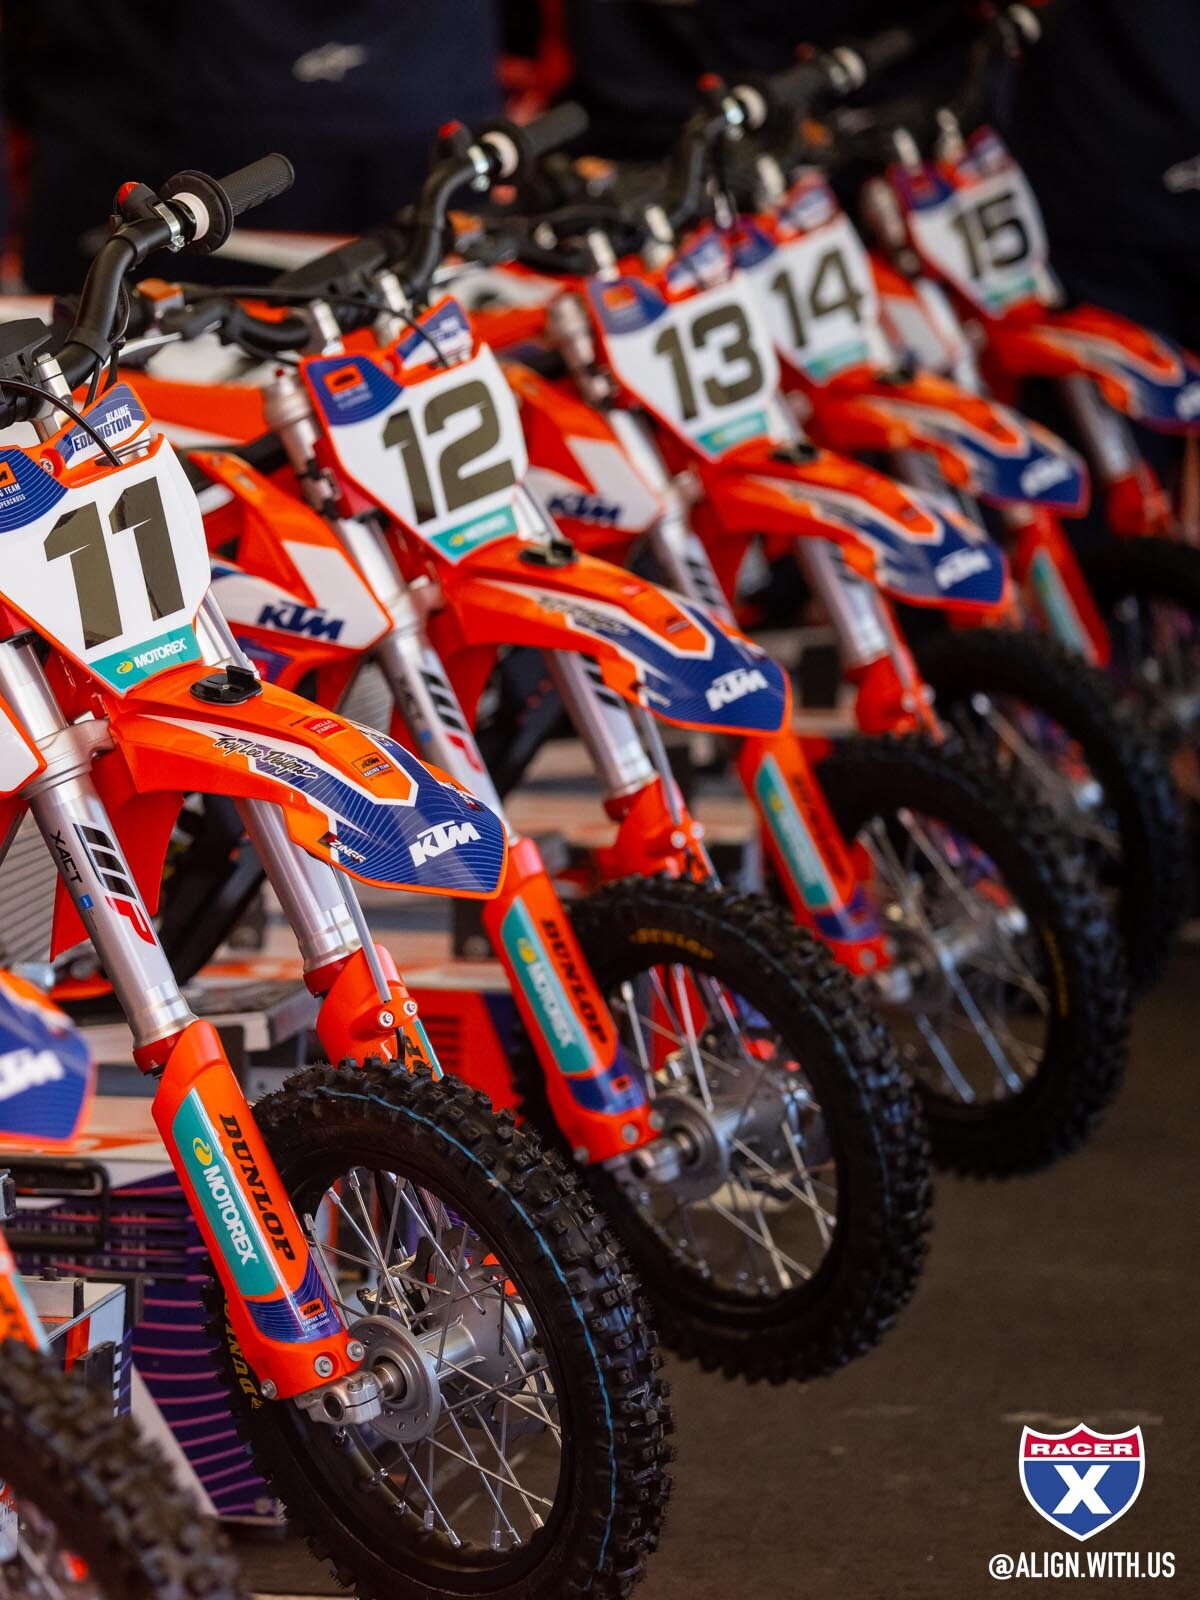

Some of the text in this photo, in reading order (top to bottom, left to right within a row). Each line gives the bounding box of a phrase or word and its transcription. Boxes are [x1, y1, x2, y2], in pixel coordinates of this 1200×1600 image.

[953, 191, 1030, 280] 15
[770, 247, 863, 349] 14
[655, 303, 765, 421] 13
[73, 414, 132, 452] EDDNGTON
[105, 404, 130, 422] BLAINE
[382, 379, 517, 526] 12
[5, 483, 22, 496] TEAM
[43, 476, 185, 650] 11
[257, 600, 345, 641] KTM
[134, 637, 187, 669] MOTOREX
[705, 667, 769, 712] KTM
[310, 719, 334, 732] WELLS
[213, 737, 318, 778] Troy Lee Designs
[50, 829, 83, 883] XACT
[408, 820, 482, 867] KTM
[540, 920, 607, 1044] DUNLOP
[219, 1113, 296, 1262] DUNLOP
[203, 1164, 256, 1266] MOTOREX
